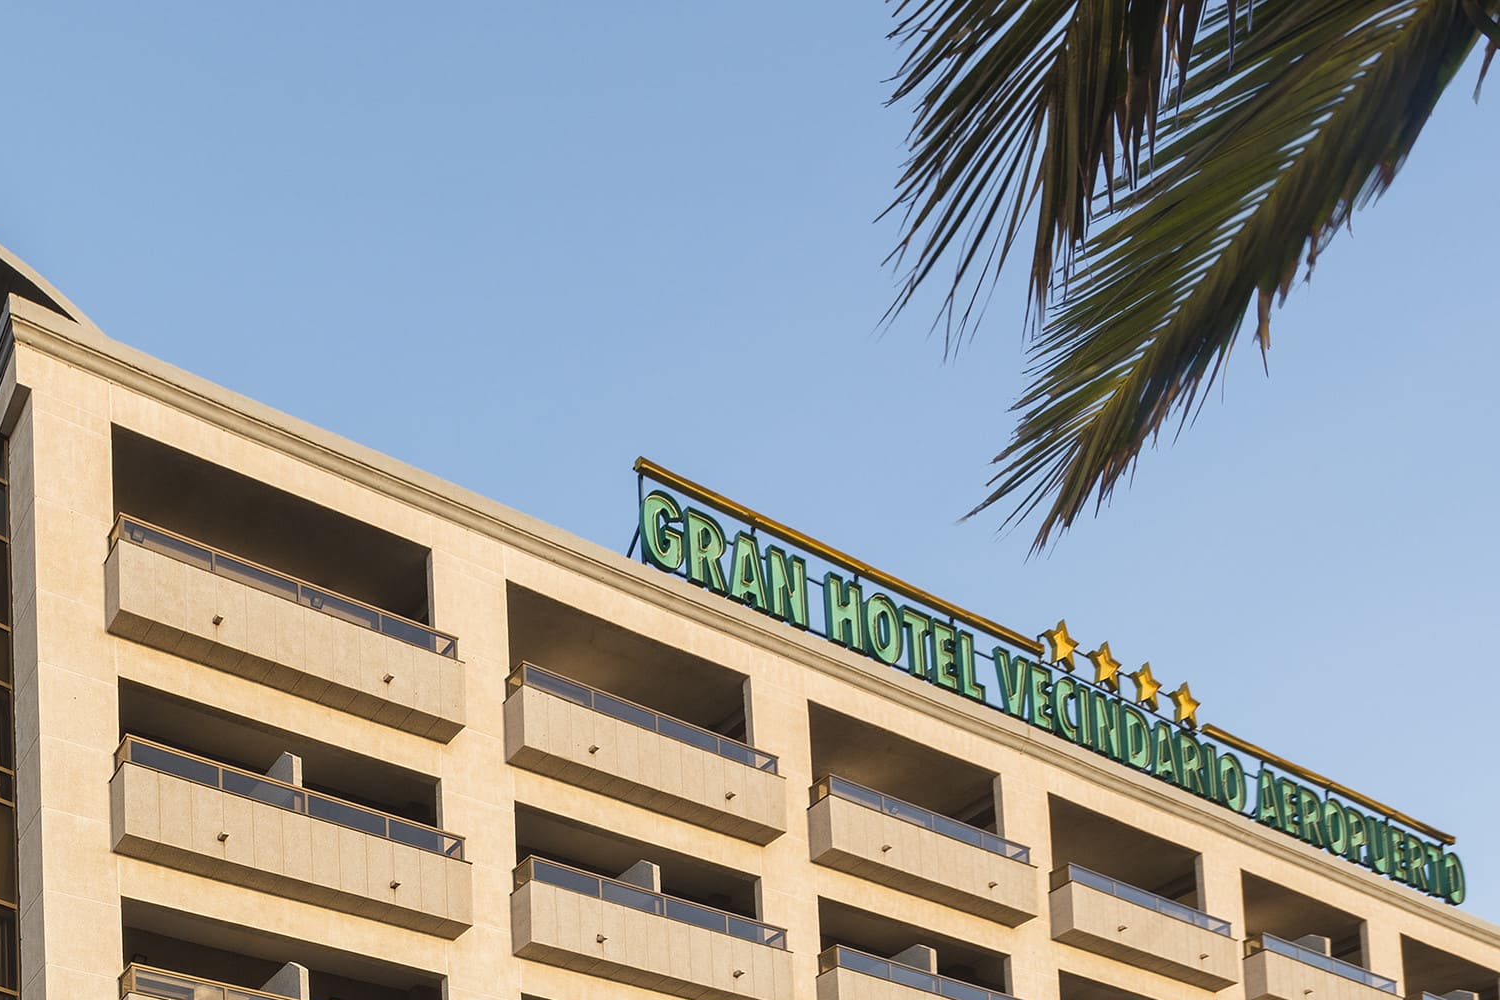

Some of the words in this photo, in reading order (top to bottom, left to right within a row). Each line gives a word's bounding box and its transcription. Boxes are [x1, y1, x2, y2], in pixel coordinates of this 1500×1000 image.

[640, 489, 811, 631] GRAN
[823, 571, 987, 701] HOTEL
[992, 645, 1248, 814] VECINDARIO
[1255, 767, 1467, 905] AEROPUERTO
